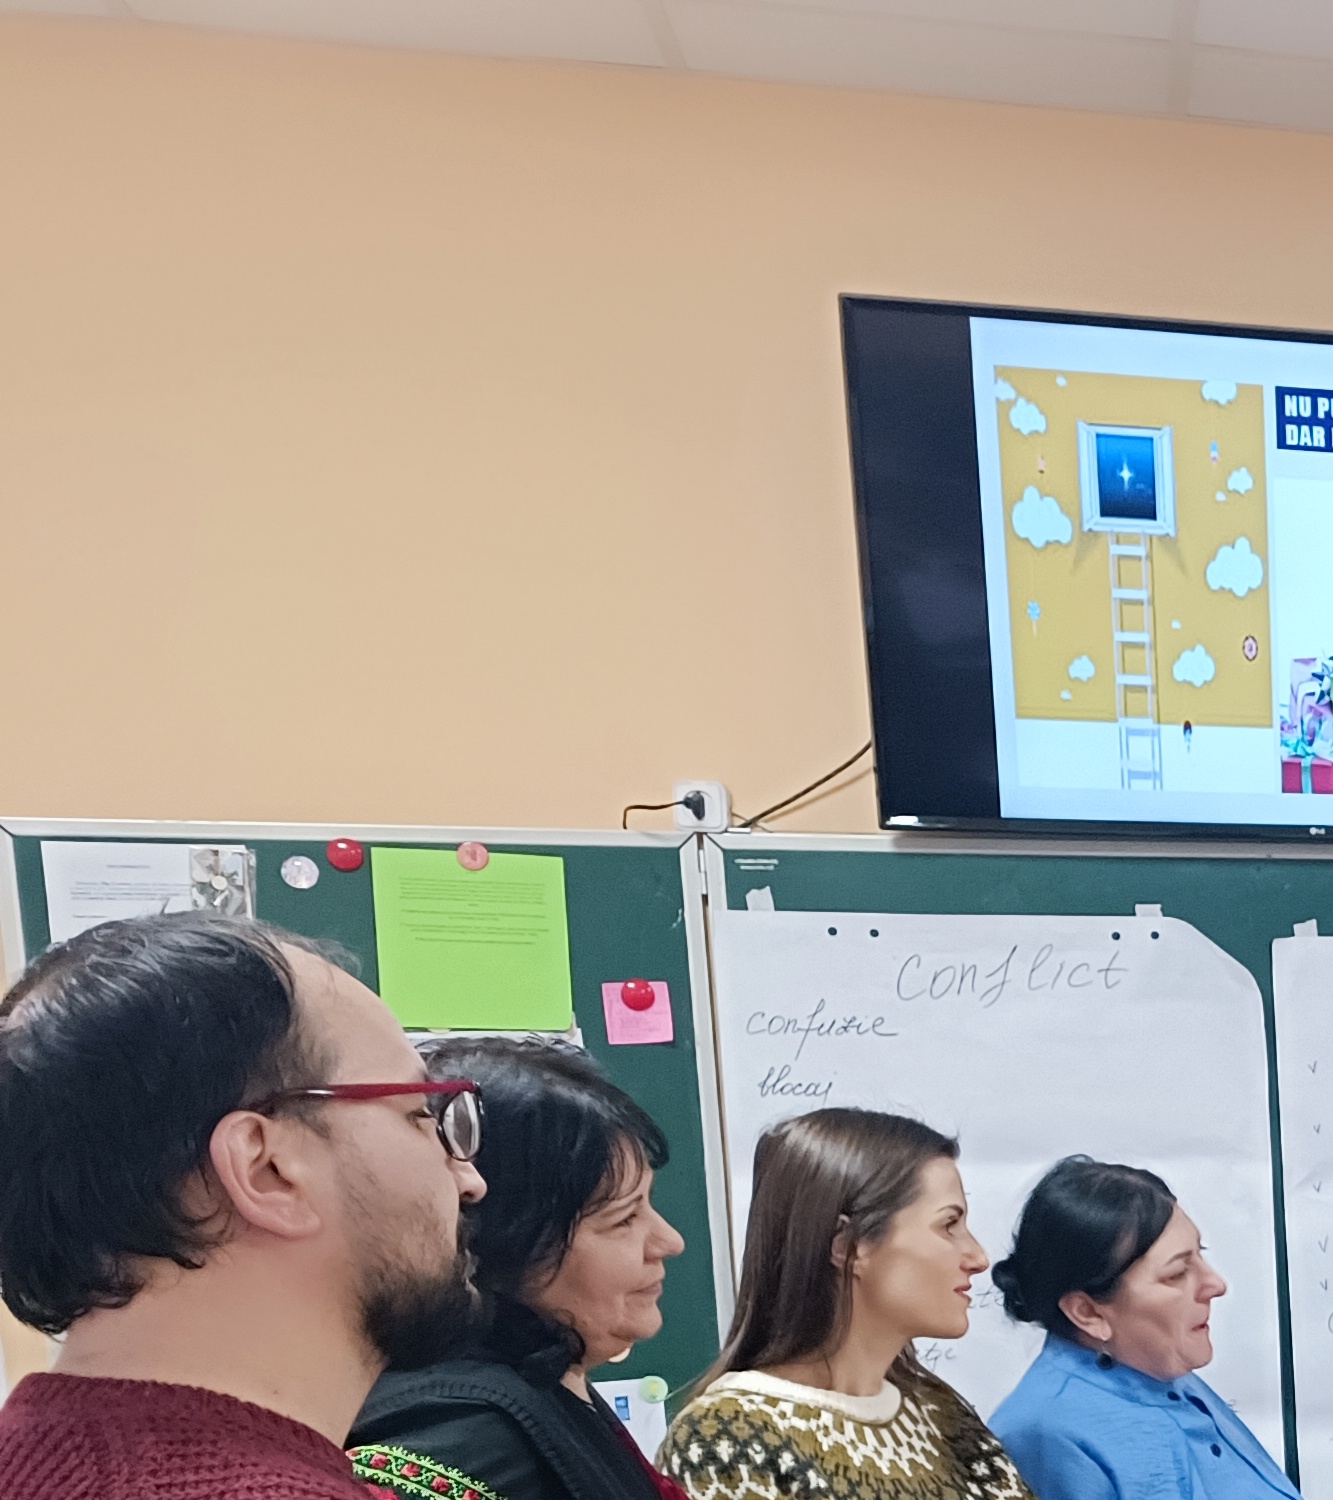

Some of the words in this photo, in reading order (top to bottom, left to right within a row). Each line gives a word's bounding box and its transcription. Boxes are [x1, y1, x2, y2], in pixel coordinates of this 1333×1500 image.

[1284, 394, 1312, 418] NU
[1285, 424, 1326, 448] DAR
[896, 943, 1131, 1008] Conflict
